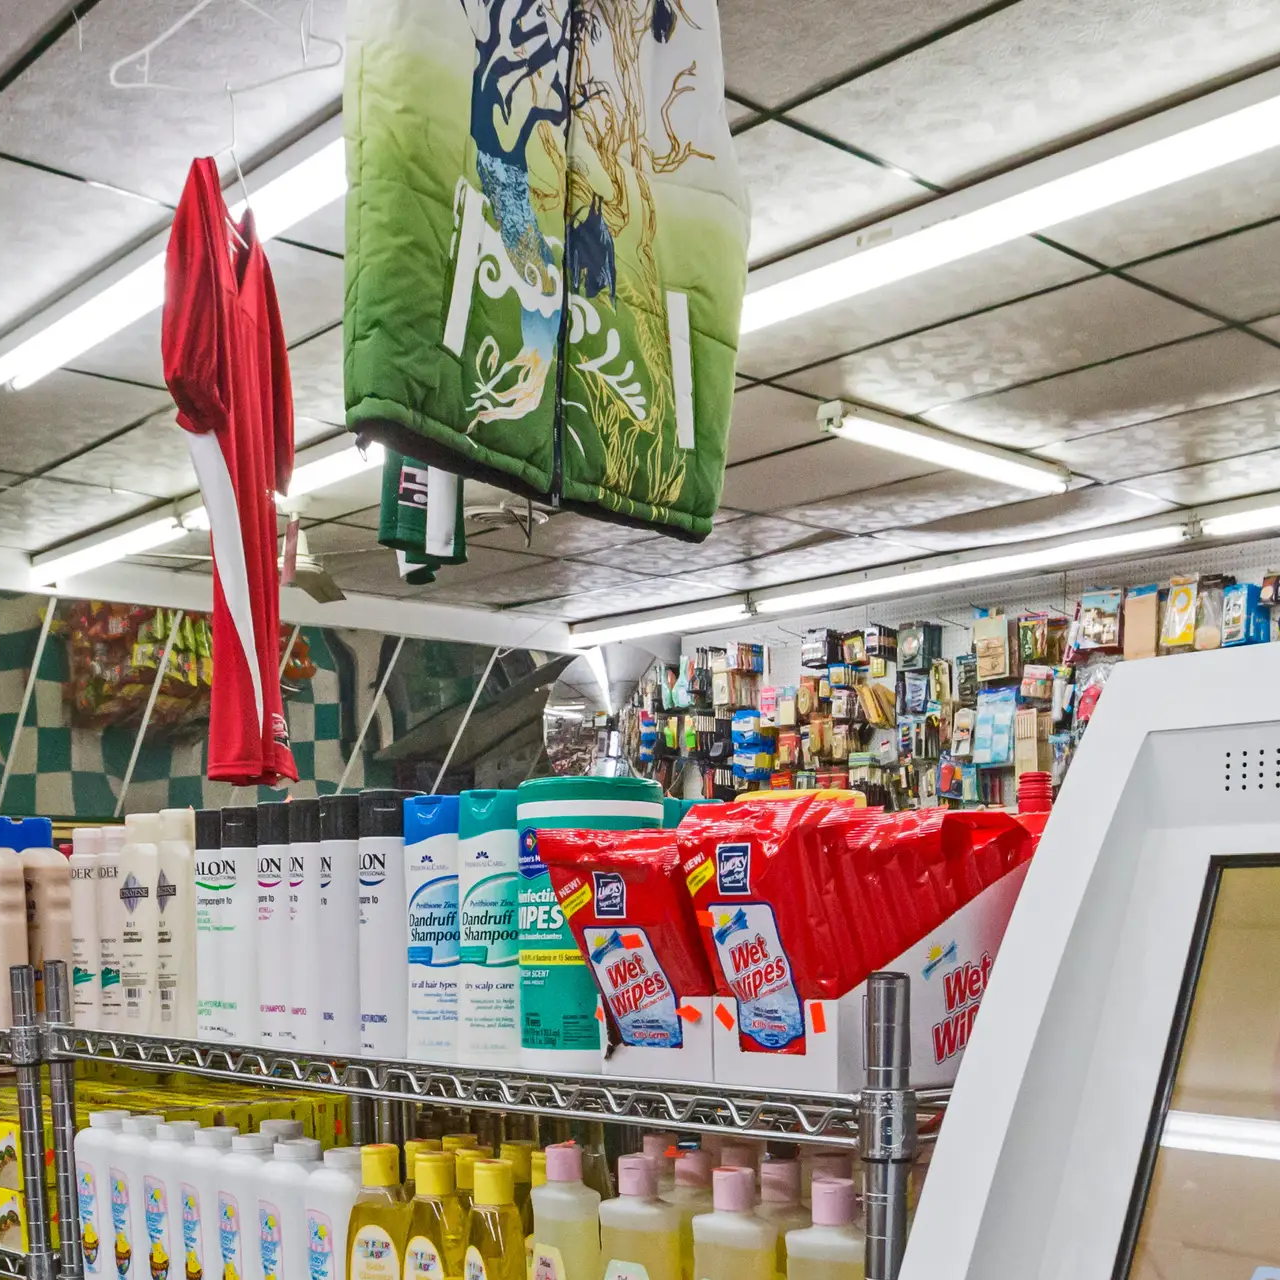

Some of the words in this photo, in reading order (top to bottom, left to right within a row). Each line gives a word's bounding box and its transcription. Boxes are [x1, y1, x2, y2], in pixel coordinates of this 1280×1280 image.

[683, 850, 706, 874] NEW!
[557, 877, 582, 899] NEW!
[409, 911, 458, 928] Dandruff
[462, 909, 514, 927] Dandruff
[411, 928, 461, 946] Shampoo
[464, 927, 518, 946] Shampoo
[728, 932, 770, 976] Wet
[606, 952, 648, 990] Wet
[730, 956, 787, 1005] Wipes
[943, 950, 994, 1014] Wet
[495, 982, 515, 990] care
[609, 970, 668, 1020] Wipes
